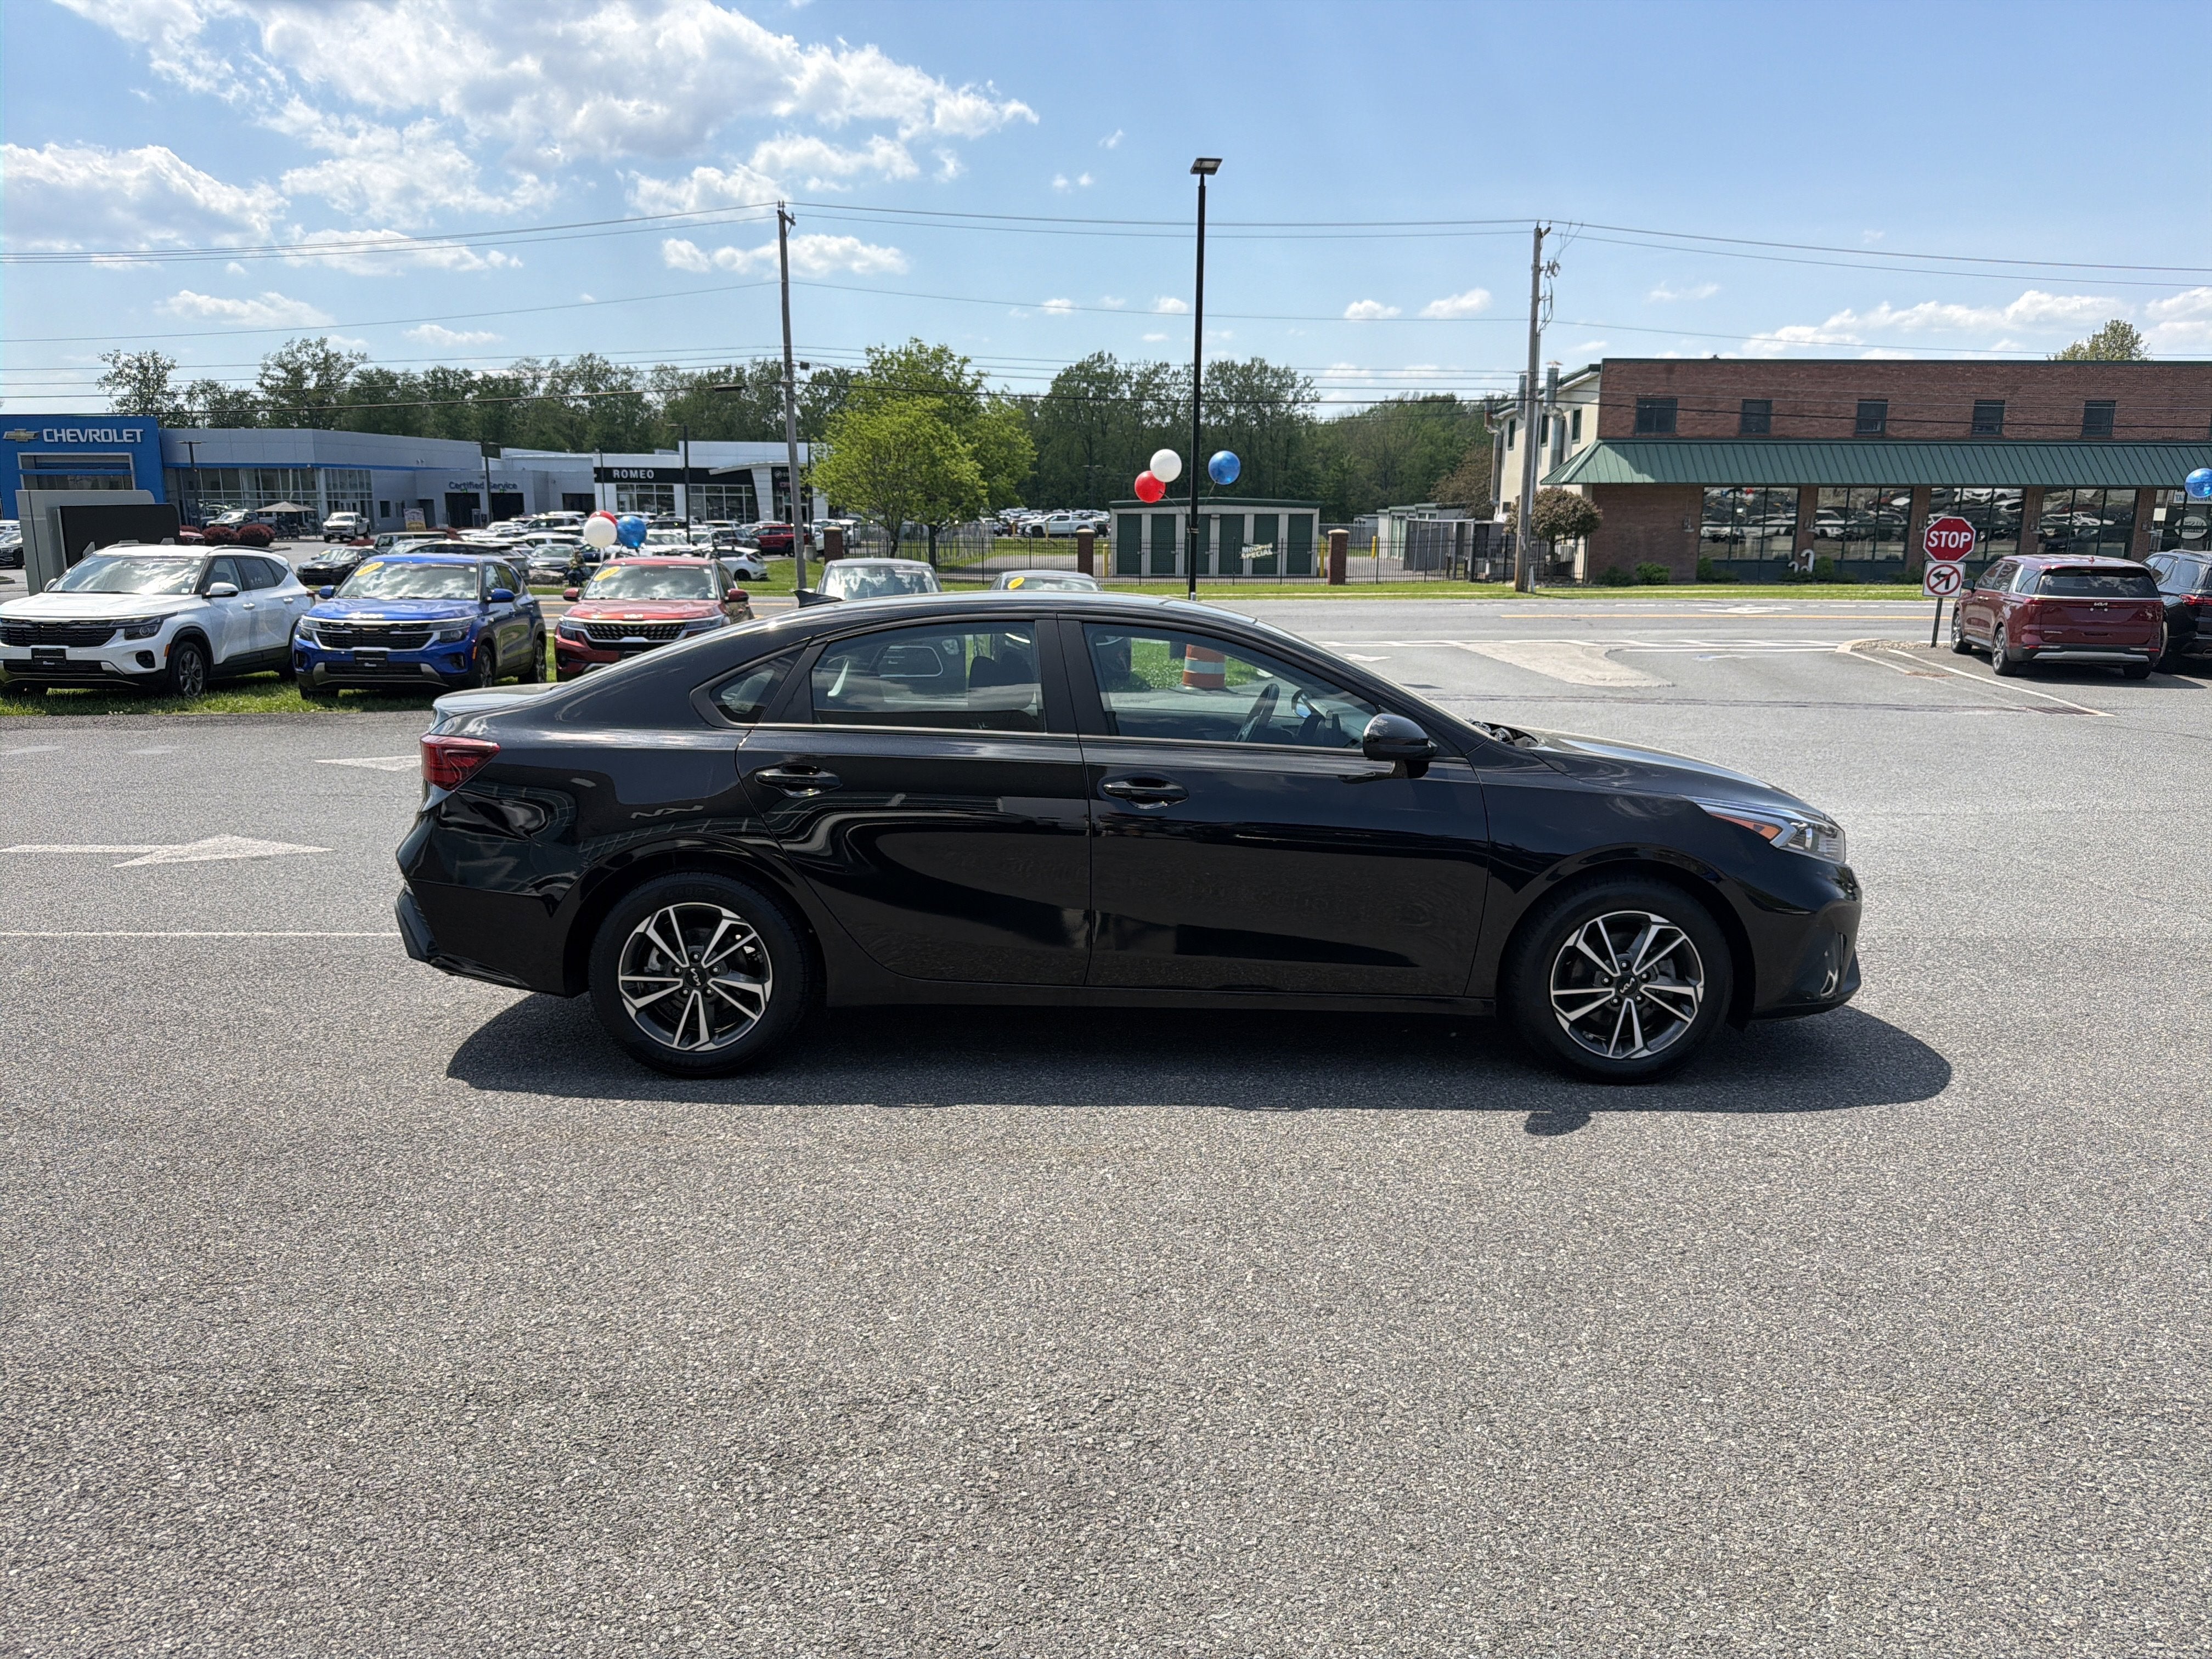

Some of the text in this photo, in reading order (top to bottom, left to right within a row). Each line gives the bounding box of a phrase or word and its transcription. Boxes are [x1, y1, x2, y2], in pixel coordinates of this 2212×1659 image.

[43, 428, 144, 443] CHEVROLET
[613, 469, 654, 479] ROMEO
[449, 481, 484, 489] Certified
[1927, 531, 1971, 549] STOP
[1241, 549, 1273, 559] SPECIAL
